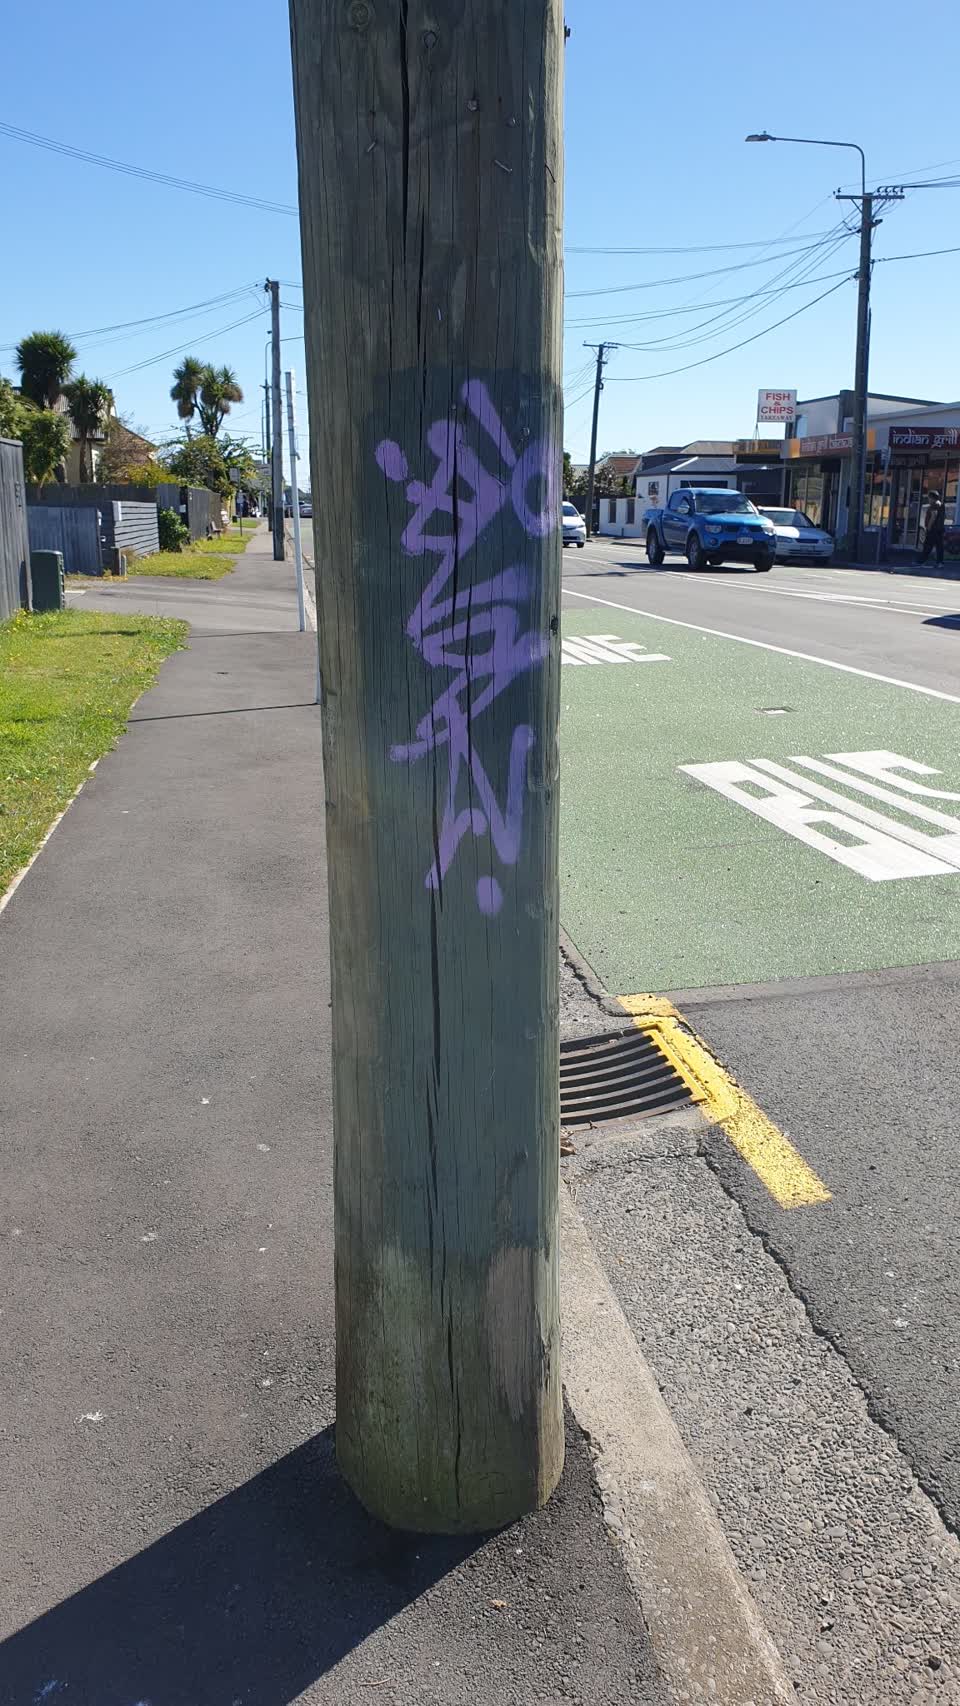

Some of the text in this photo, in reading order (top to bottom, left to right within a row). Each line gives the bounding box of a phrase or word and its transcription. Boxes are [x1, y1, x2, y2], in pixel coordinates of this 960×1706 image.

[765, 392, 791, 401] FISH
[761, 406, 794, 414] CHIPS
[892, 428, 958, 448] indian grill
